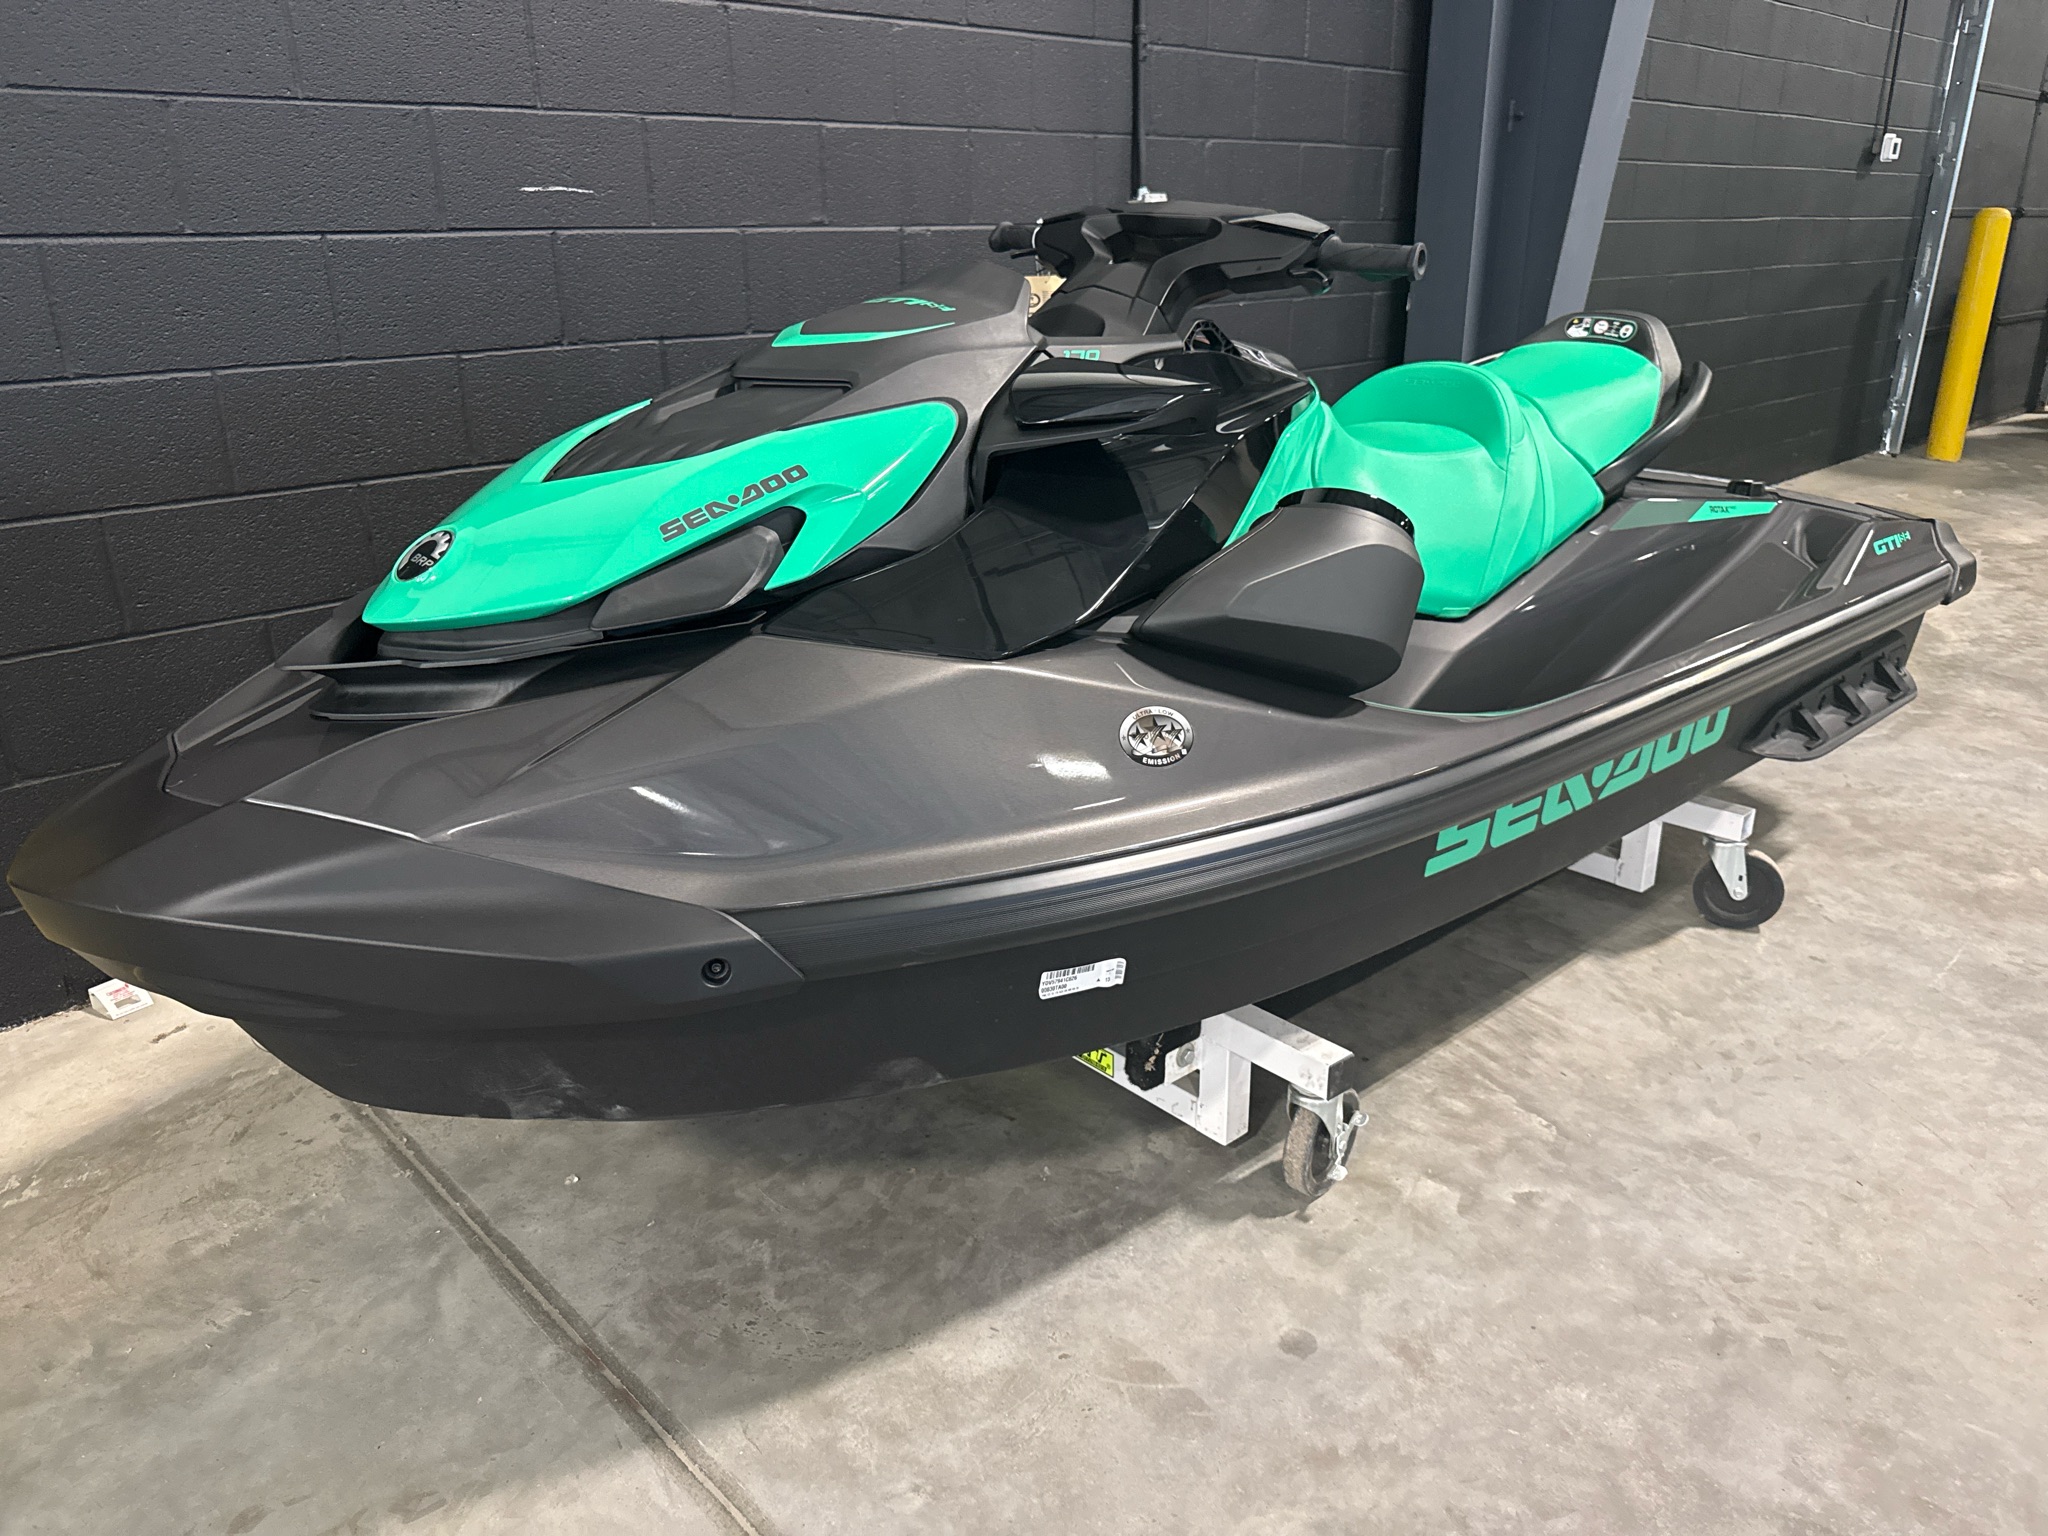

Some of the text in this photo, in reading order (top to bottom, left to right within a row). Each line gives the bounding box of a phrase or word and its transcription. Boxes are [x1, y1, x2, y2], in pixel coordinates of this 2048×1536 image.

[410, 553, 435, 567] BRP
[1132, 708, 1175, 720] ULTRA LOW
[1142, 752, 1181, 766] EMISSION
